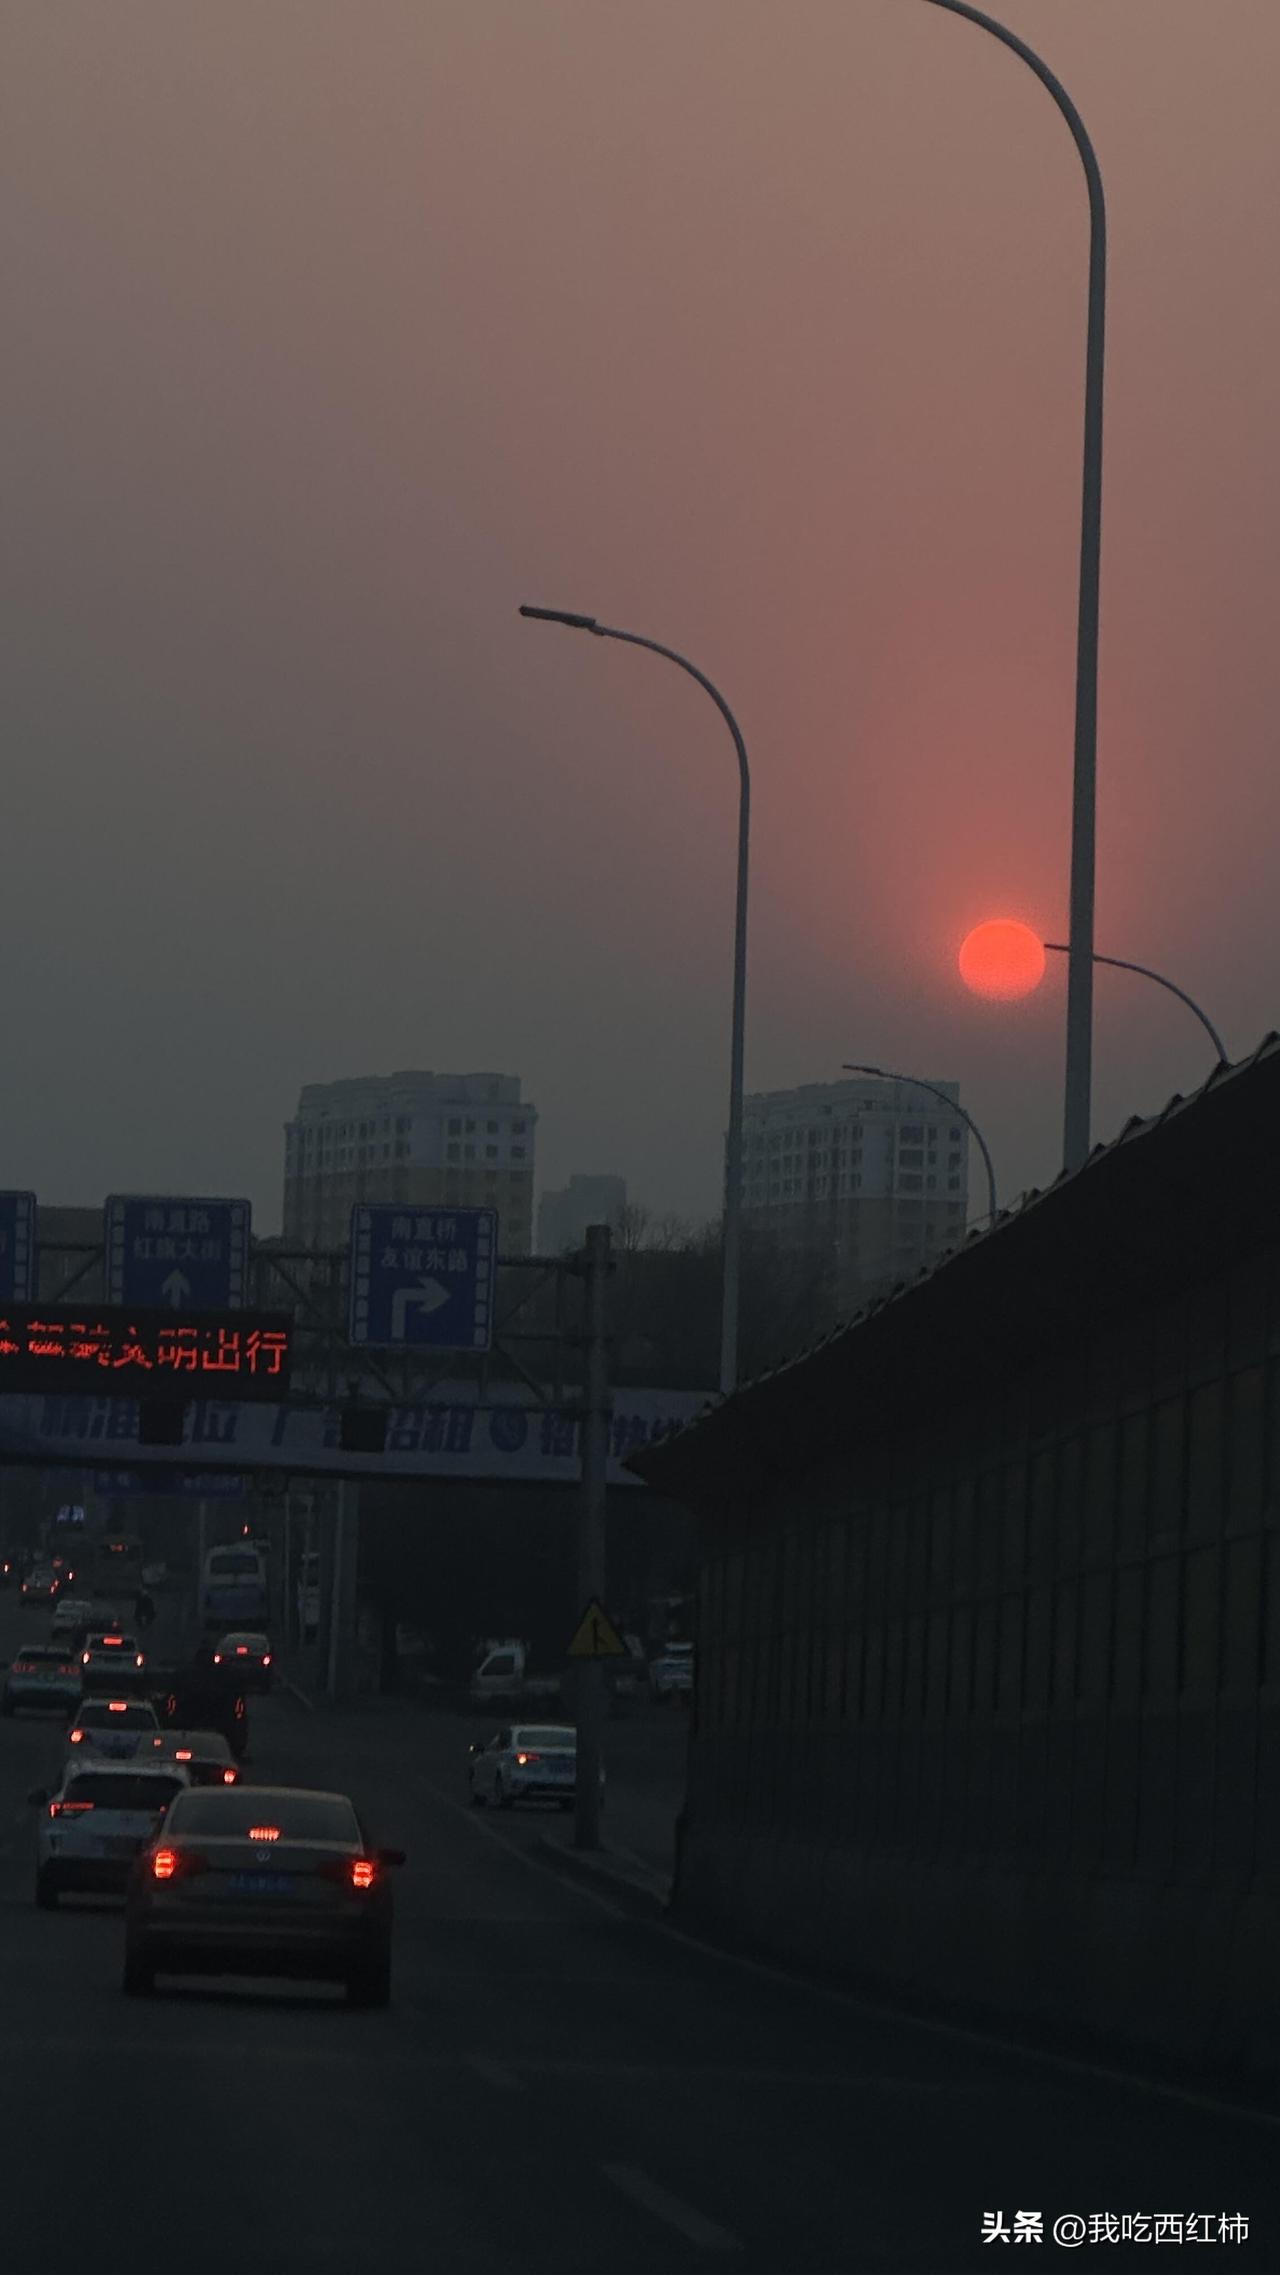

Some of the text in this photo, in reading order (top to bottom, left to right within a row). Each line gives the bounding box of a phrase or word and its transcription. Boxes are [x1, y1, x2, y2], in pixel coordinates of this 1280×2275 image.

[392, 1216, 457, 1241] 南直桥
[381, 1246, 469, 1272] 友谊东路
[40, 1396, 237, 1442] 精准位
[270, 1406, 475, 1453] 广招租
